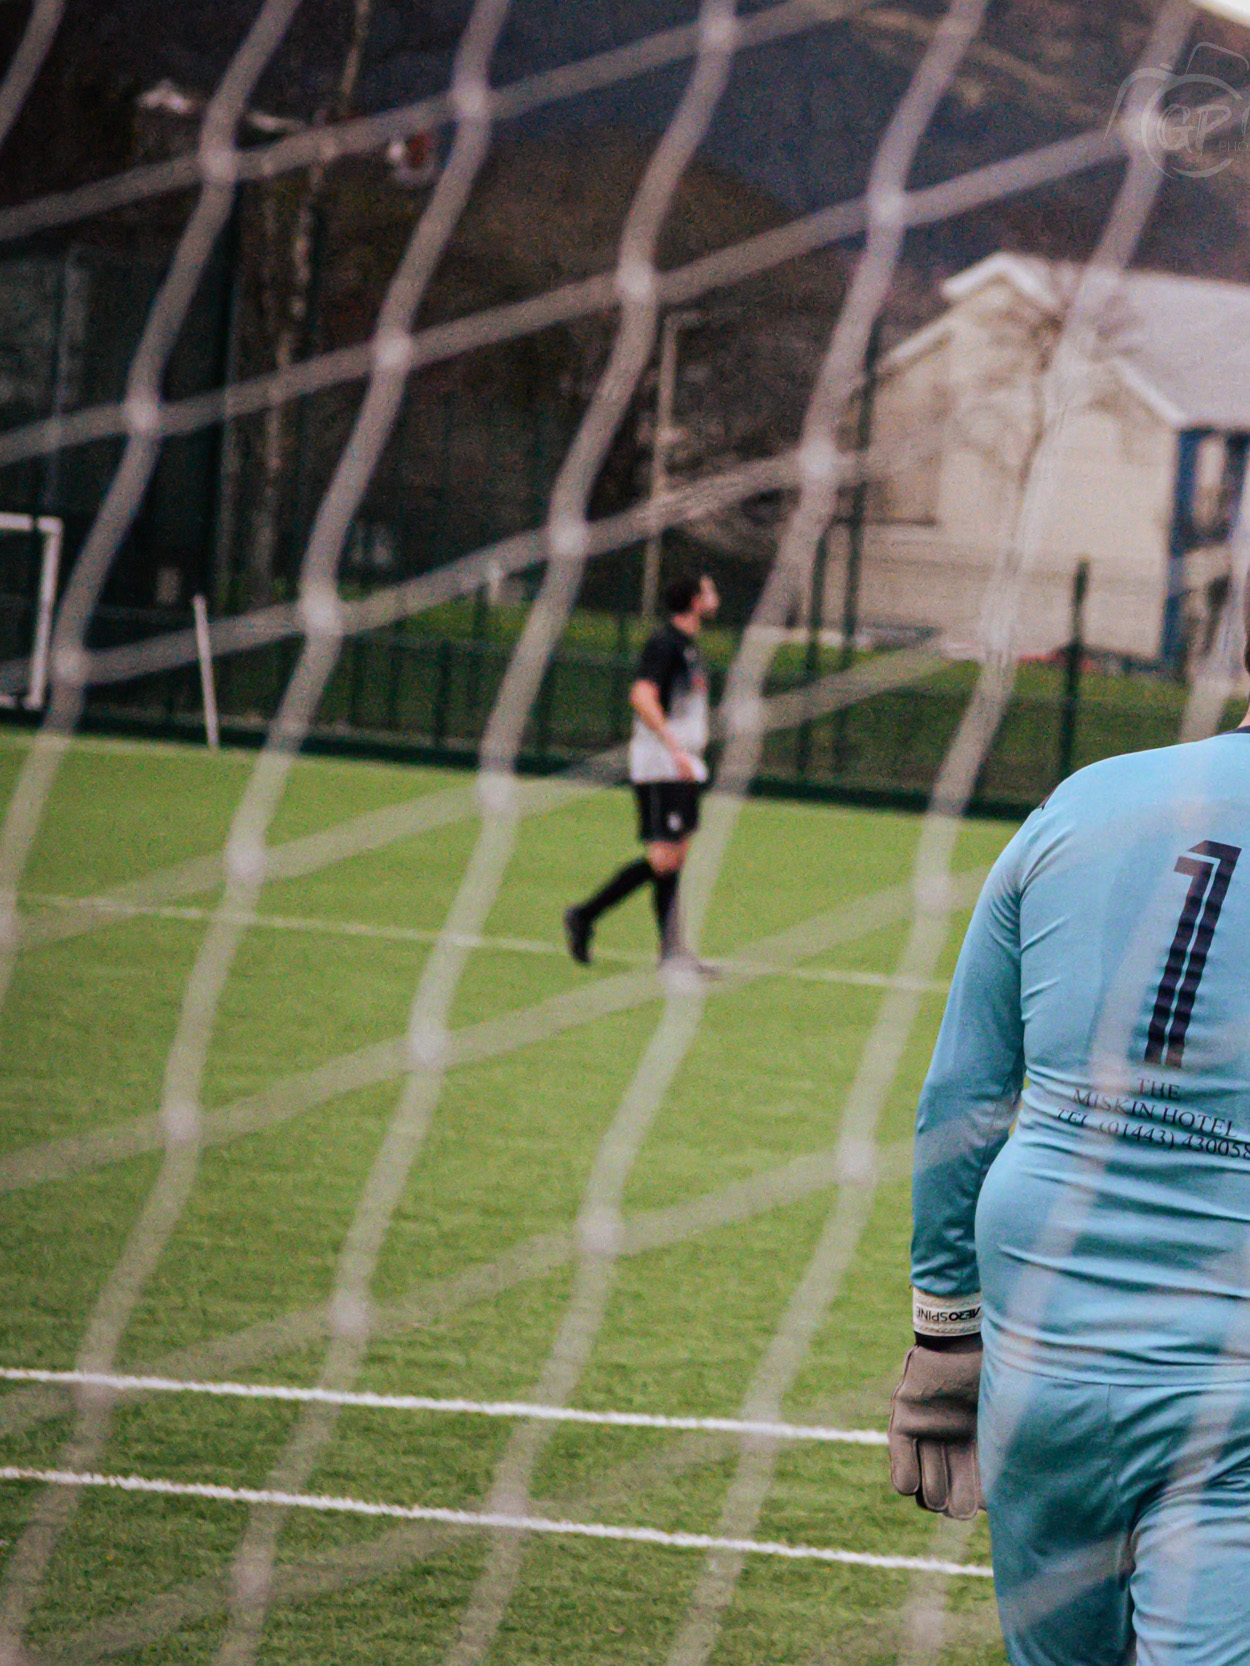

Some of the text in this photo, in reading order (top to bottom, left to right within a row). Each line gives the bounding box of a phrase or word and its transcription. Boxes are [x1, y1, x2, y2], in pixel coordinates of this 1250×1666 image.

[1144, 840, 1242, 1068] 1
[1138, 1078, 1181, 1100] THE
[1073, 1089, 1240, 1138] MISKIN HOTEL
[1099, 1120, 1175, 1150] (01443)
[915, 1306, 981, 1322] AEROSPINE
